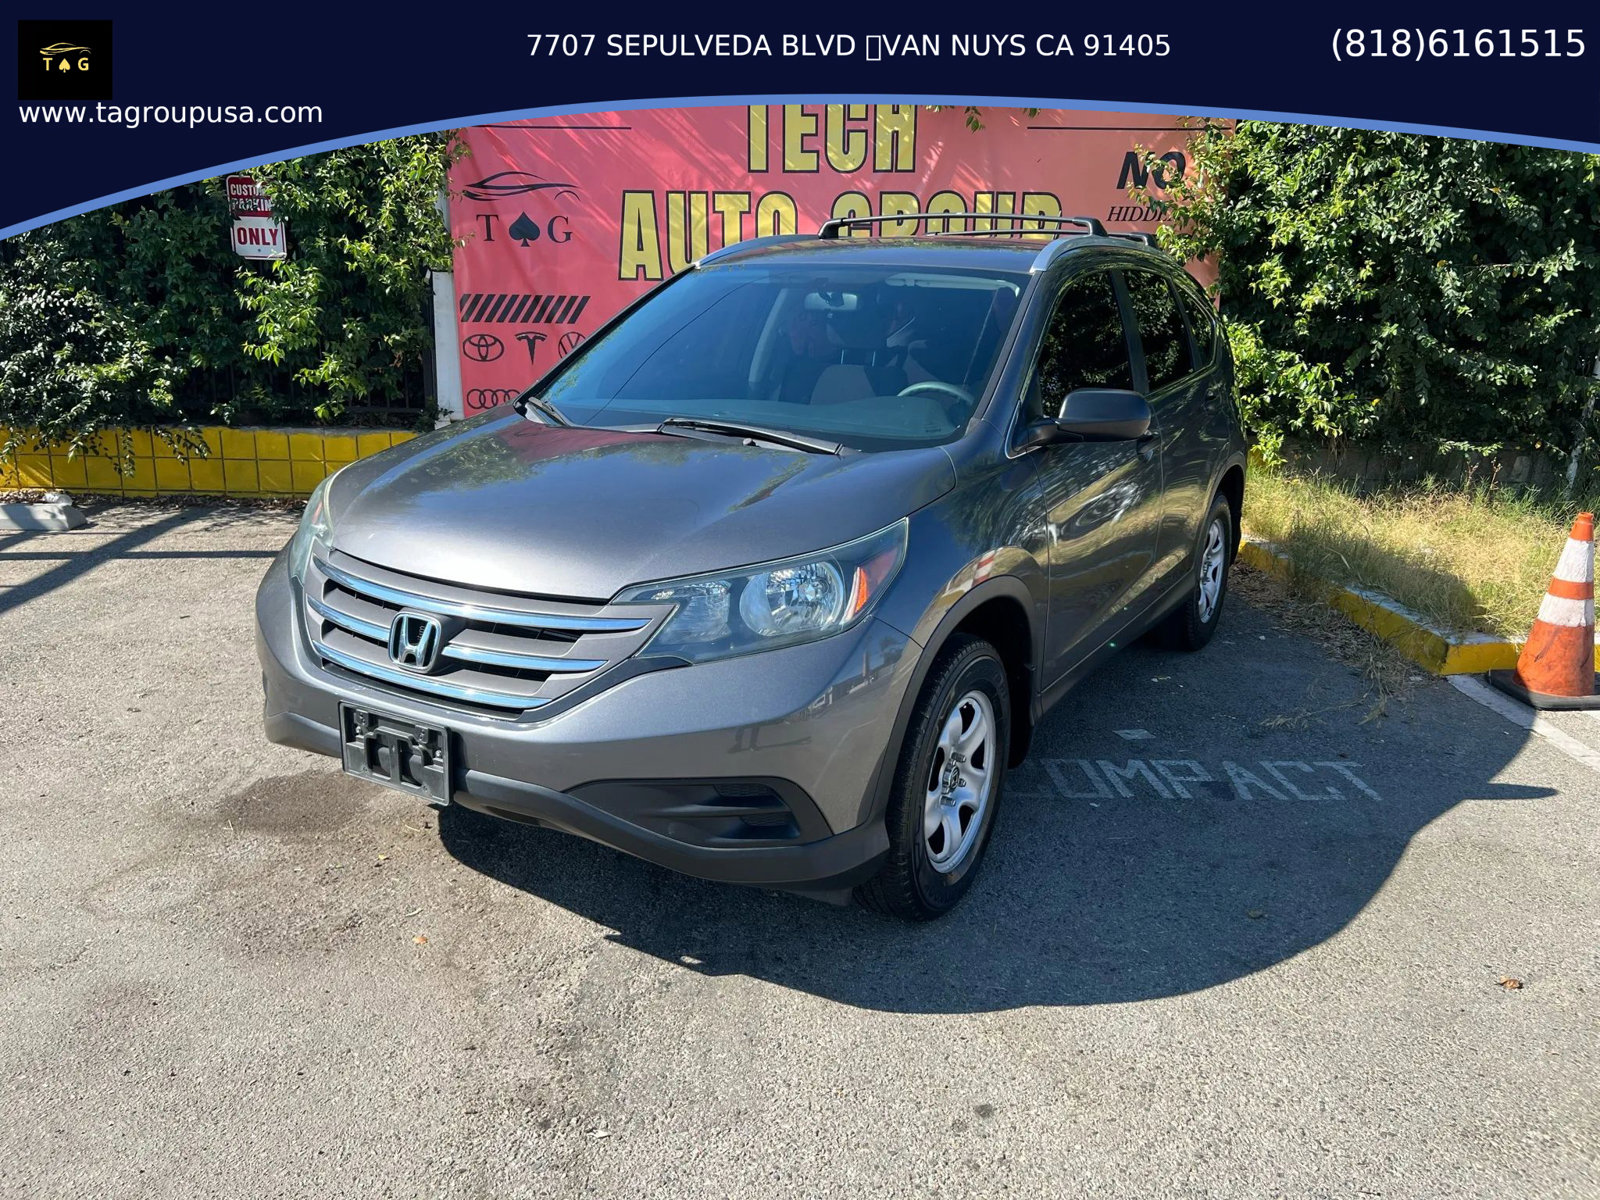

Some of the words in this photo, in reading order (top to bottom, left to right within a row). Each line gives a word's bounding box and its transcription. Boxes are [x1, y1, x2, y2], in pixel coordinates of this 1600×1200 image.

[748, 104, 917, 173] TECH
[1116, 151, 1186, 190] NO
[231, 197, 273, 212] PARKIN
[1107, 206, 1173, 222] HIDDE
[237, 227, 279, 246] ONLY
